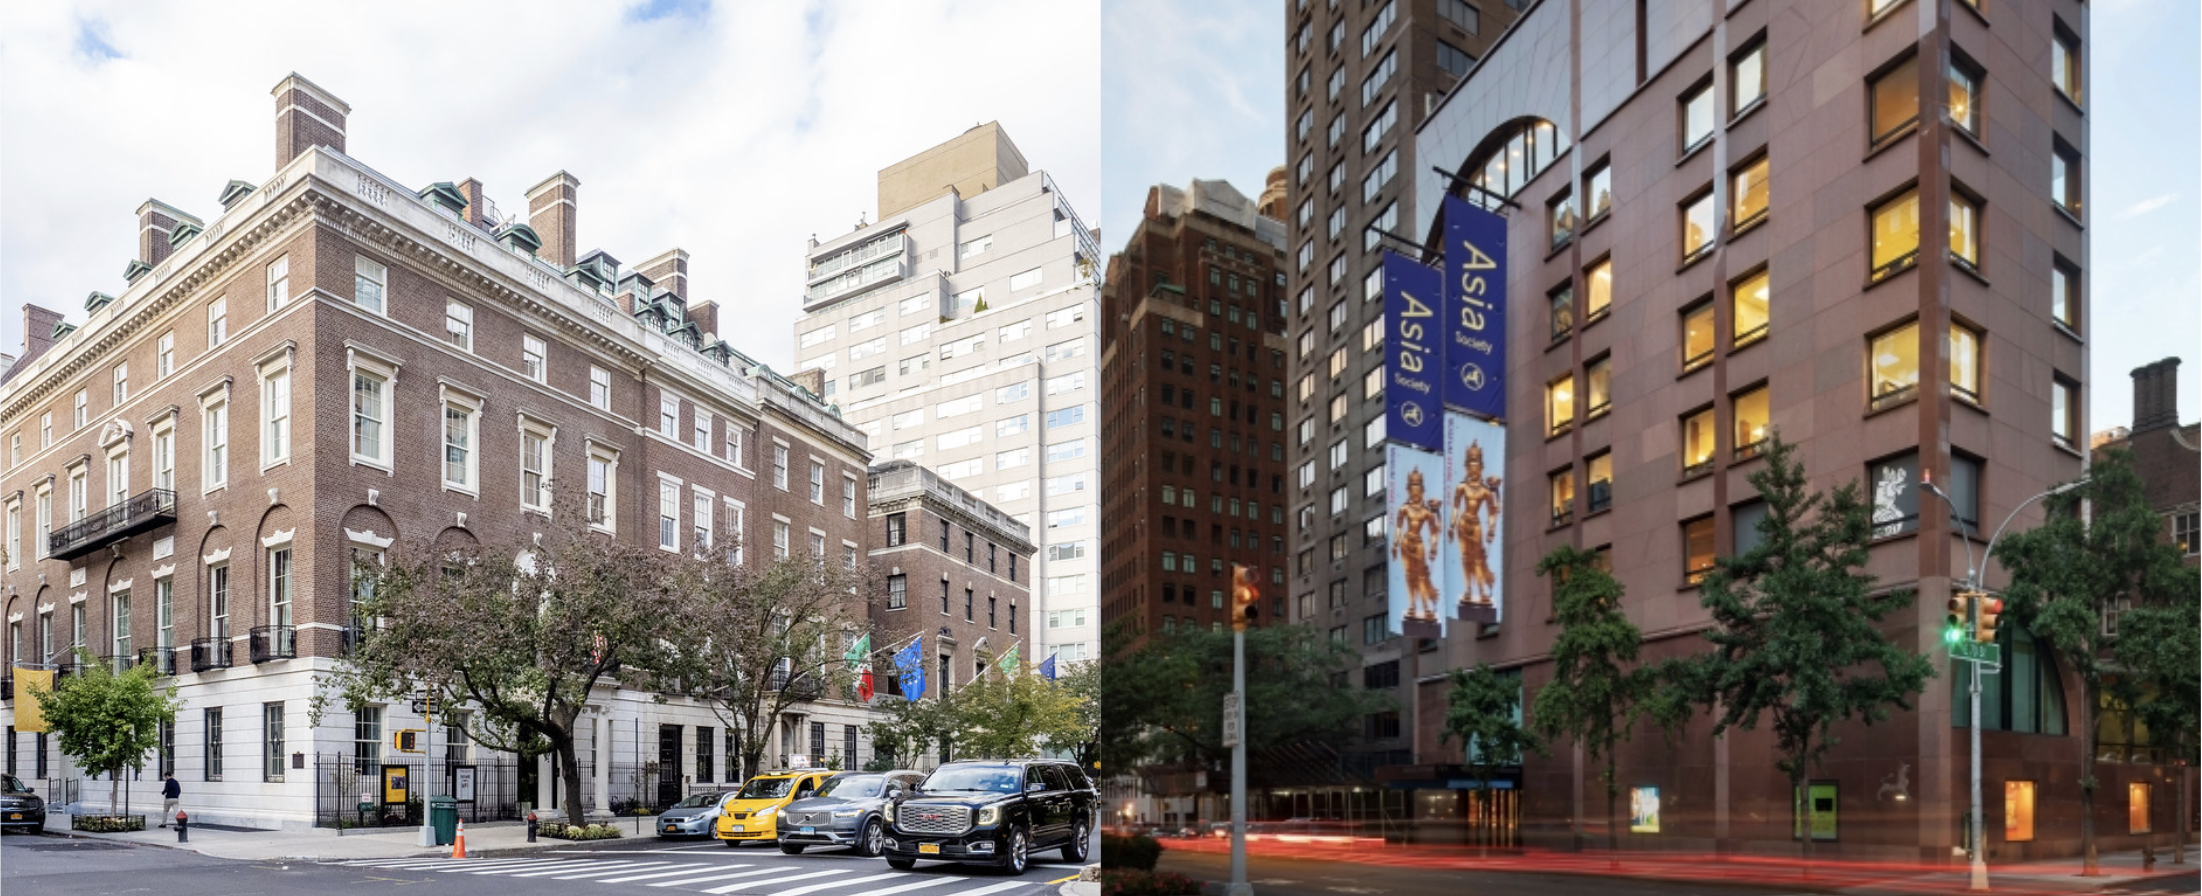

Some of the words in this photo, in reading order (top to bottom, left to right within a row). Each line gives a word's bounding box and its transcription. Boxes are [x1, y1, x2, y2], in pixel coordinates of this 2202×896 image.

[1462, 240, 1497, 331] Asia
[1400, 290, 1434, 373] Asia
[1455, 330, 1493, 356] Society
[1394, 372, 1432, 395] Society
